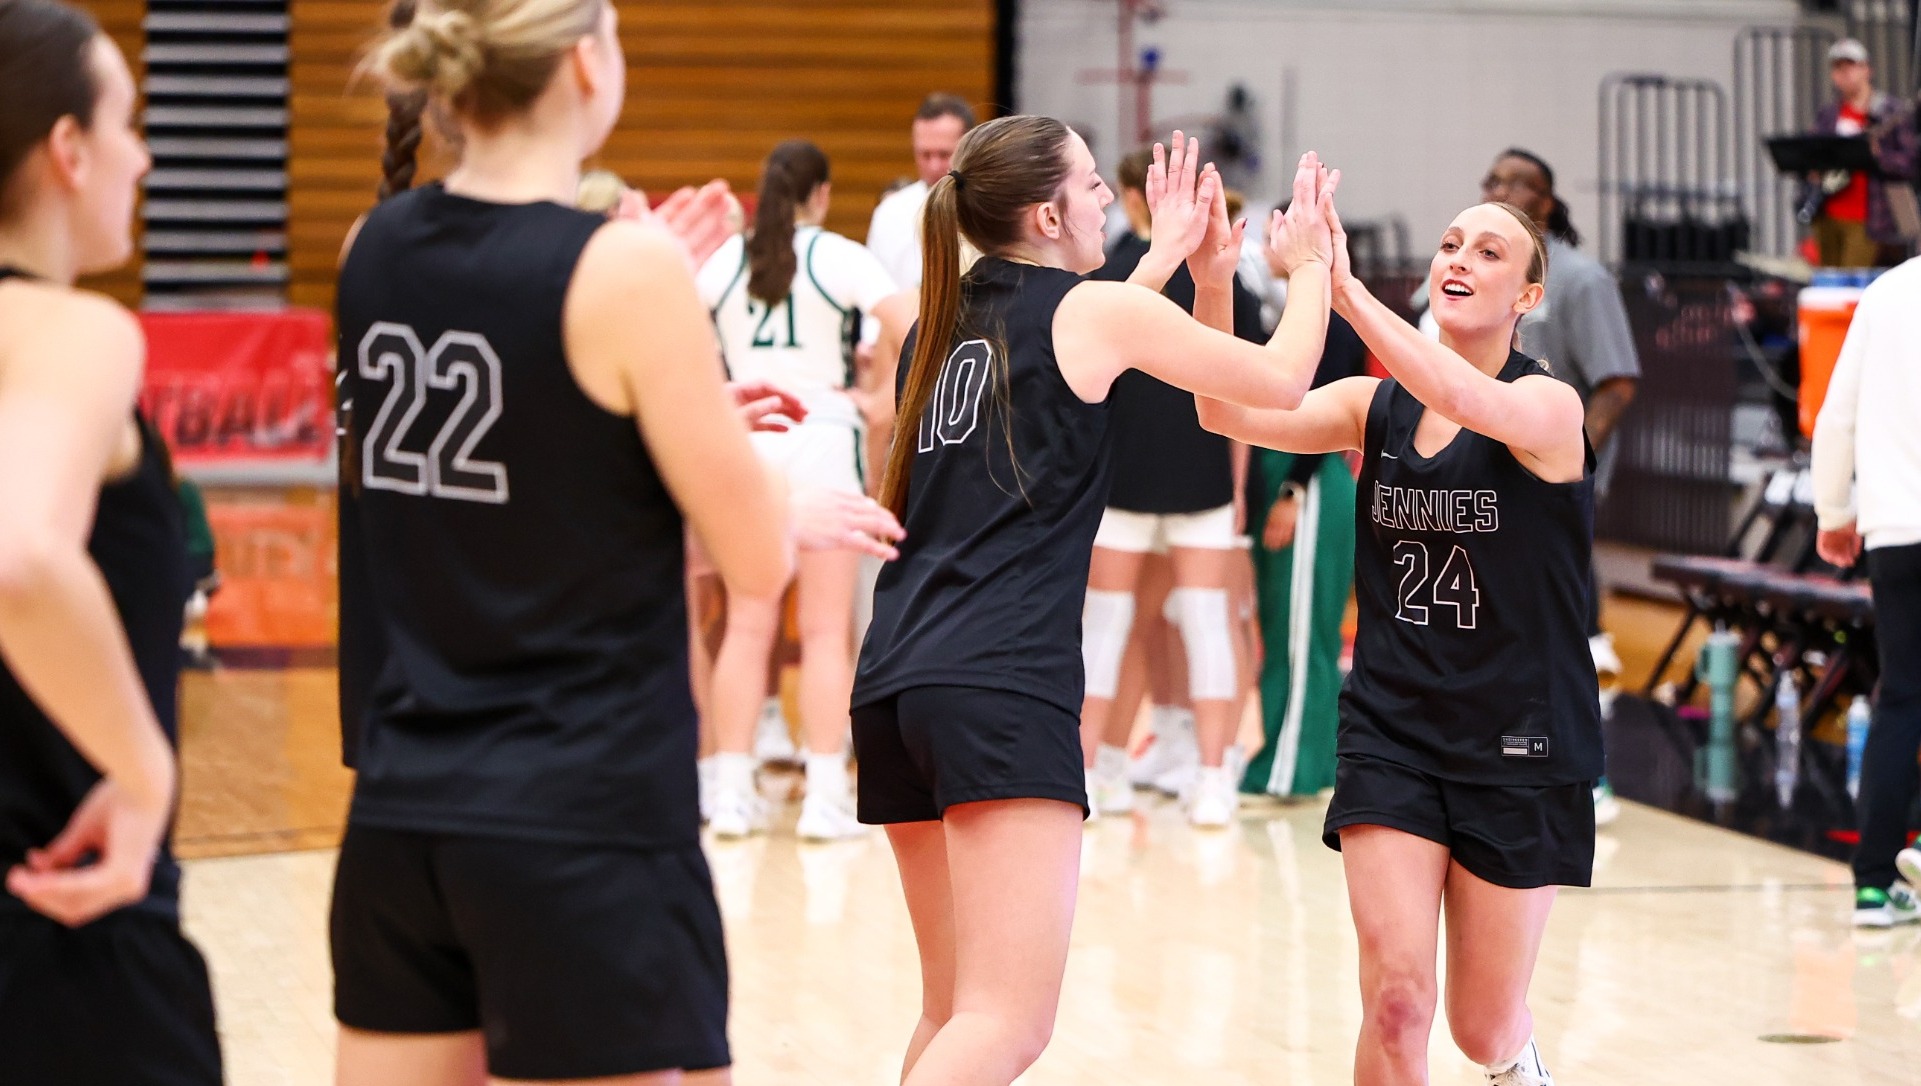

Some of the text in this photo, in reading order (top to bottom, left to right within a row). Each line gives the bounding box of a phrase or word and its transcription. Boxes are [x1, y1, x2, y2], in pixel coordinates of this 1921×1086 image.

[747, 287, 803, 348] 21
[144, 384, 318, 447] TBALL
[358, 321, 510, 505] 22
[917, 338, 993, 454] 10
[1371, 479, 1500, 534] JENNIES
[1392, 540, 1481, 630] 24
[1533, 742, 1543, 752] M
